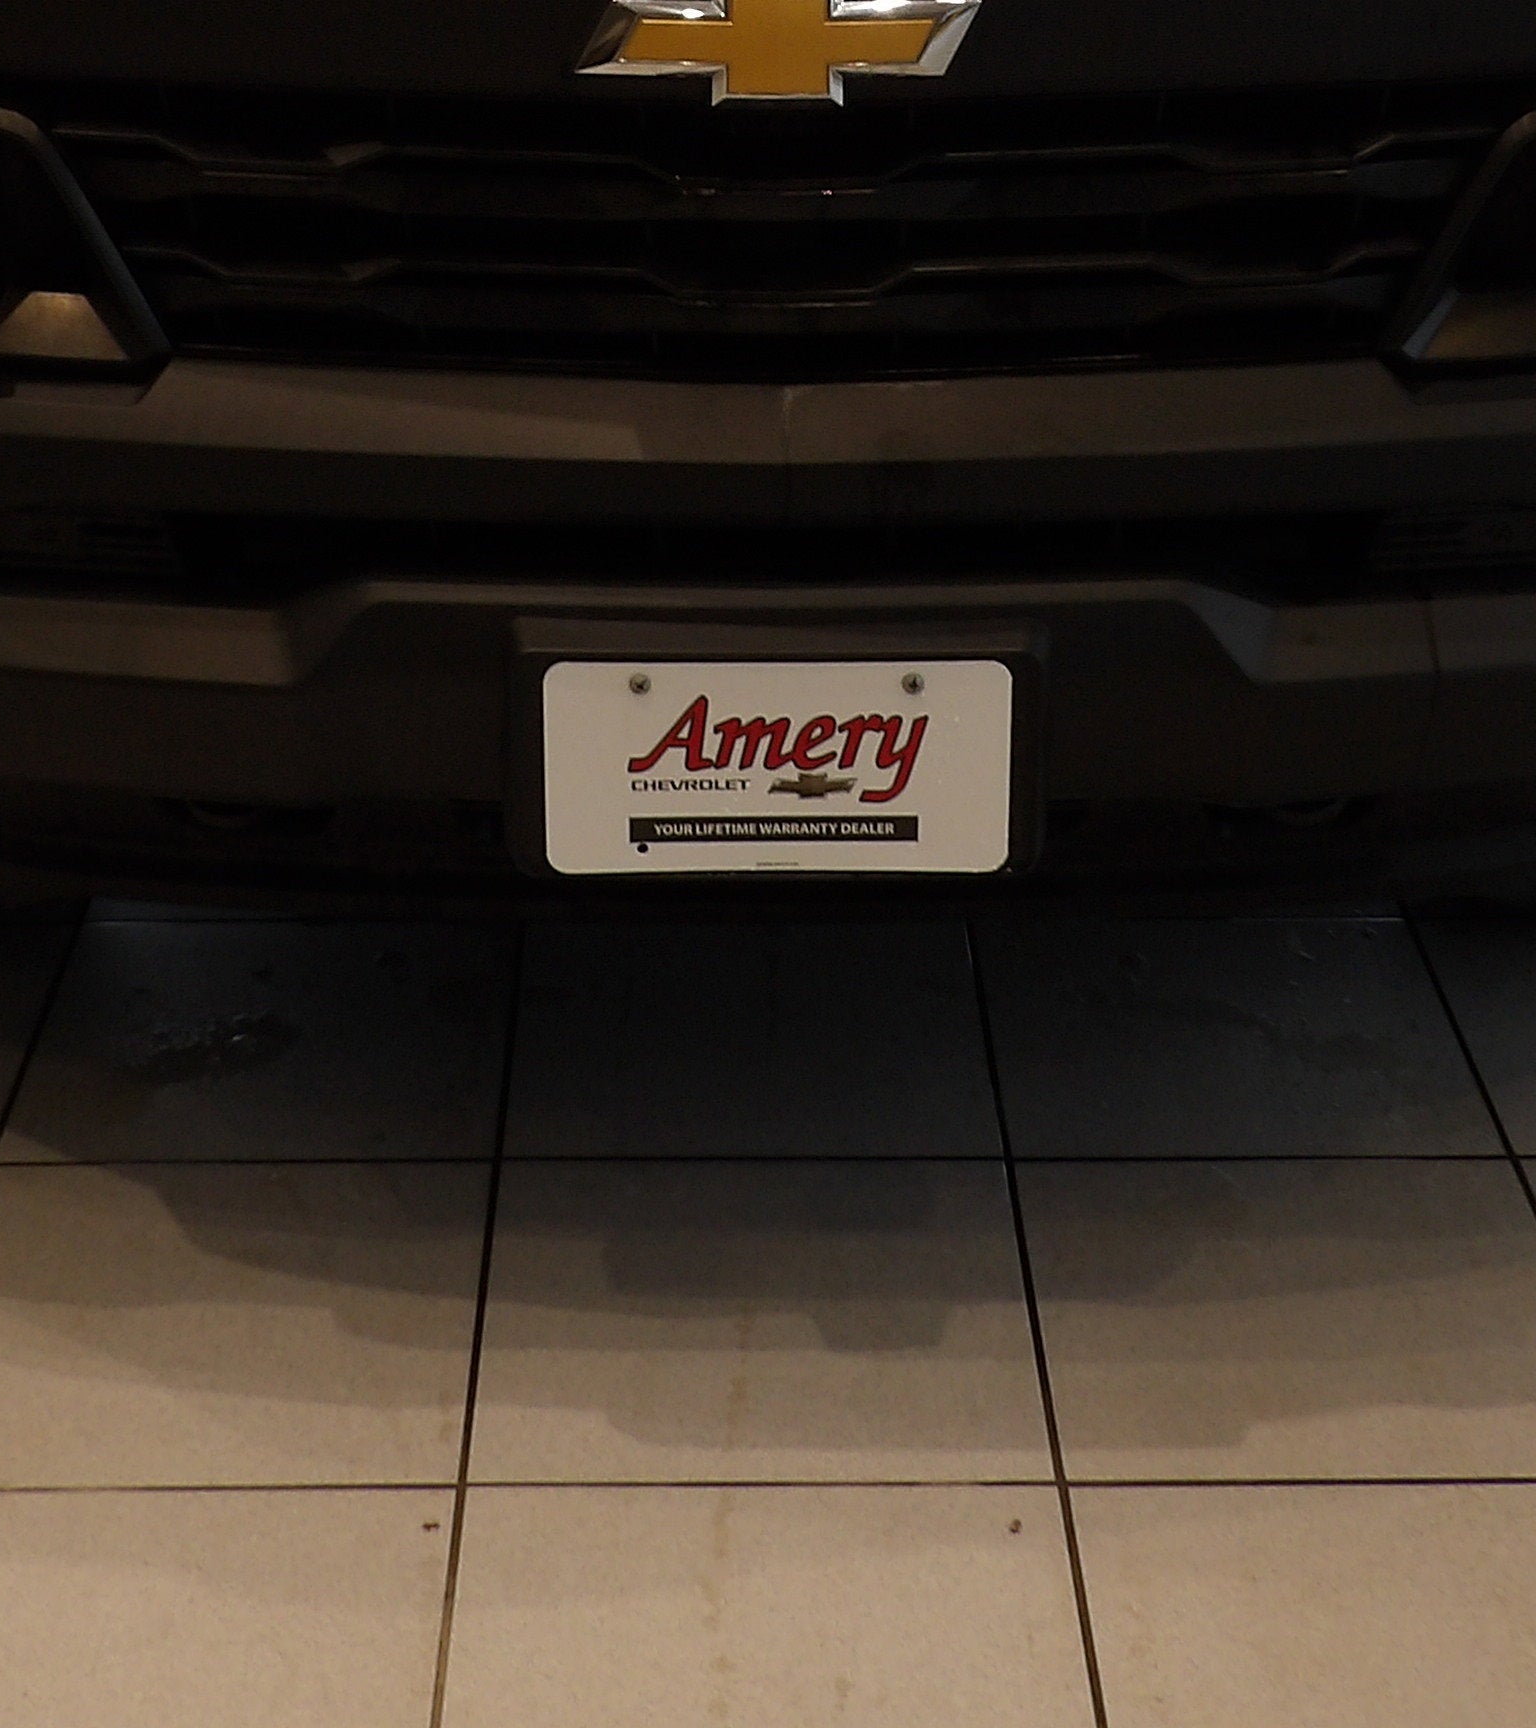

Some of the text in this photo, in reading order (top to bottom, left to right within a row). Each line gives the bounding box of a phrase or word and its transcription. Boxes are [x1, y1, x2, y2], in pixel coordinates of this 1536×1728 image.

[628, 694, 929, 803] Amery
[631, 779, 750, 791] CHEVROLET
[654, 822, 895, 836] YOUR LIFETIME WARRANTY DEALER
